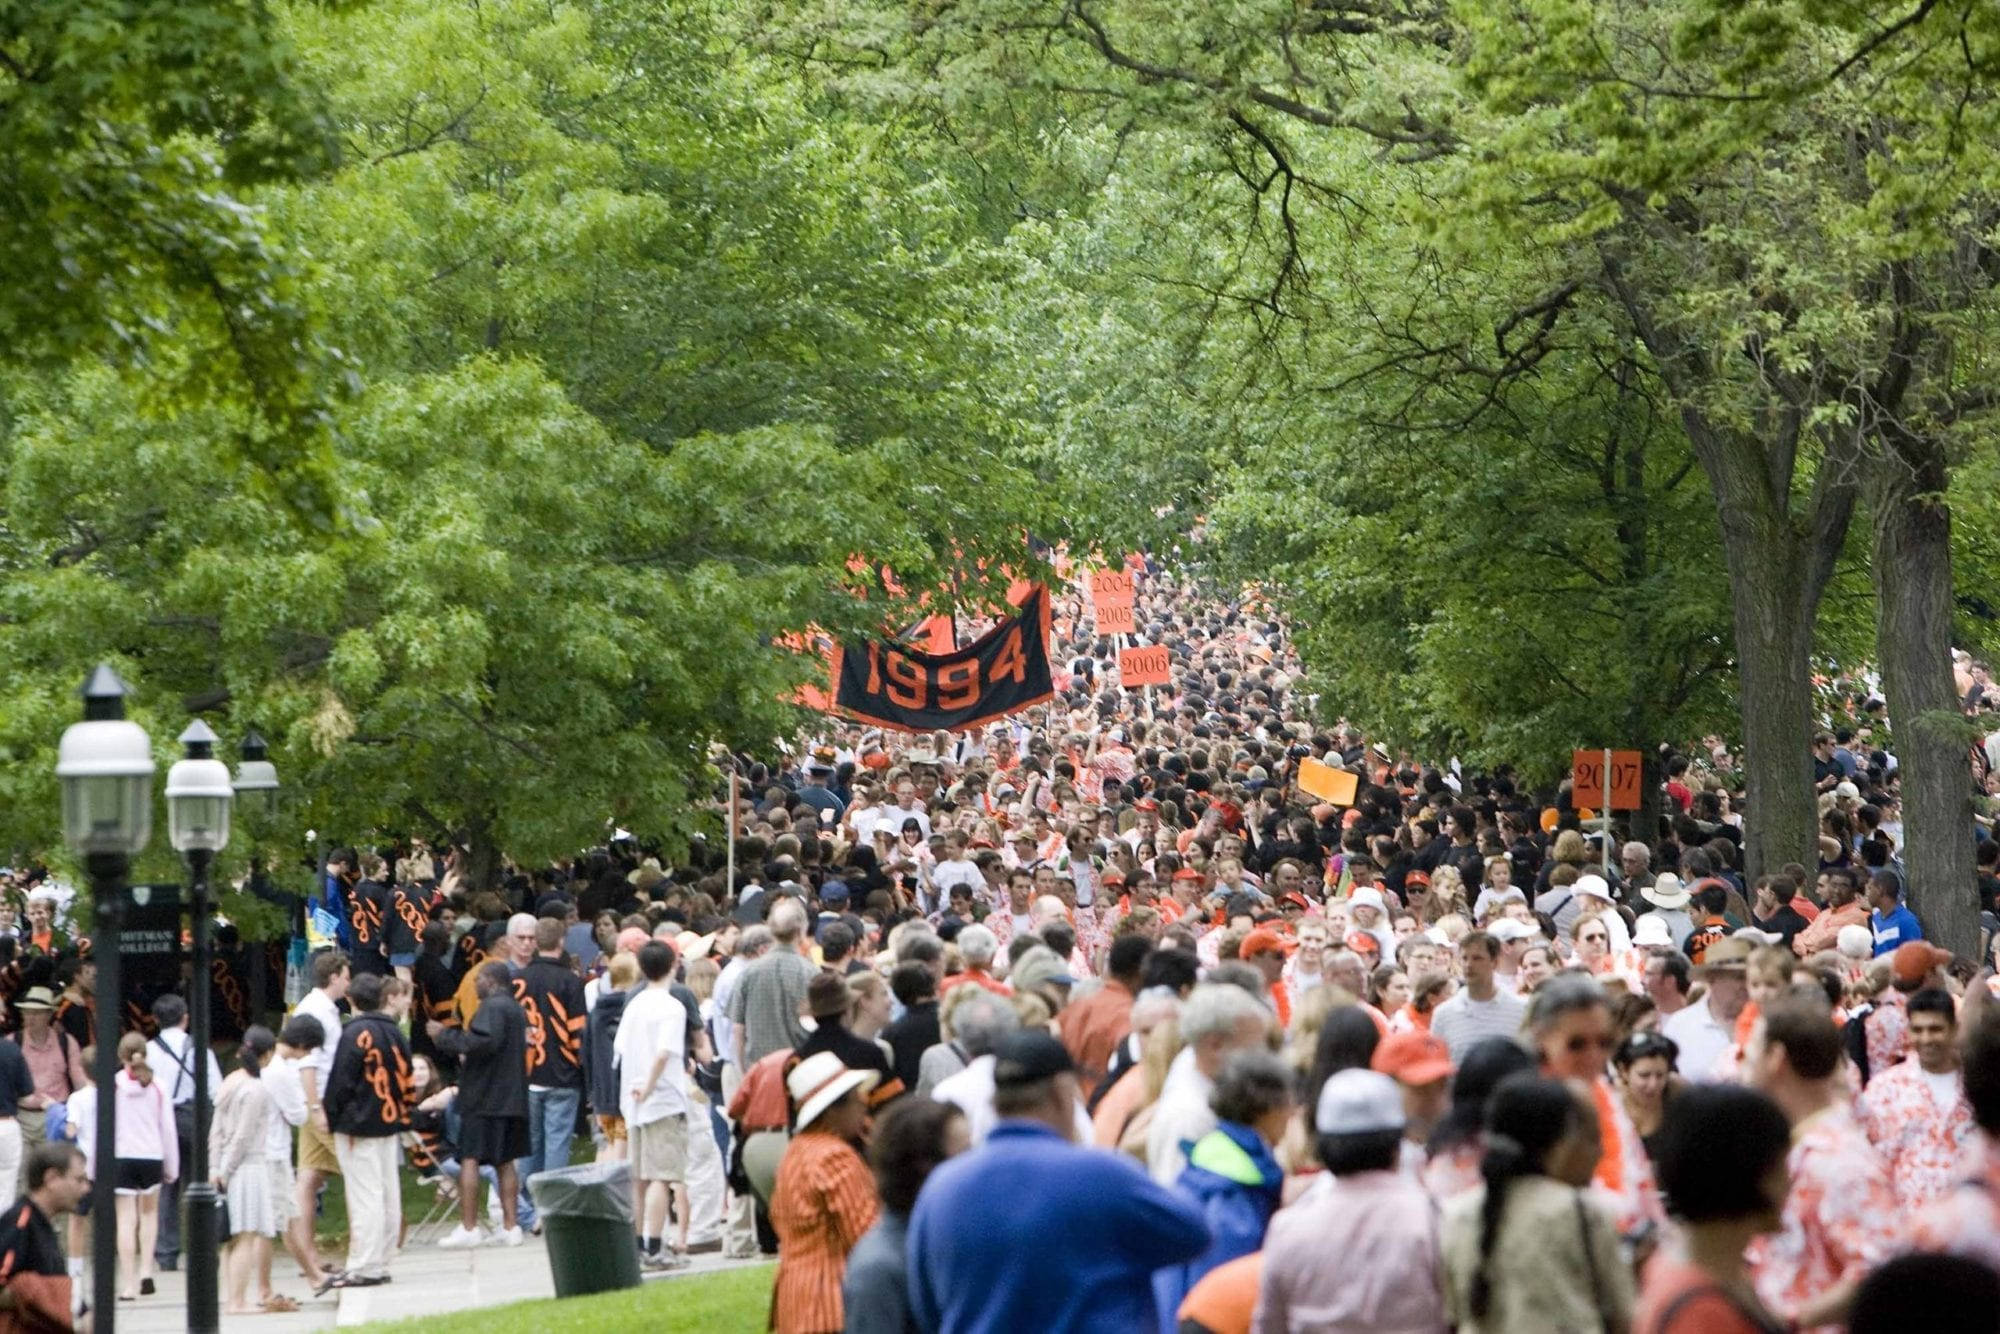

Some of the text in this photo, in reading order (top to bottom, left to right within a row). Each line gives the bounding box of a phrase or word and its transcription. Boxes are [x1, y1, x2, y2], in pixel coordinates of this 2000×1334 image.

[1094, 575, 1133, 593] 2004
[1097, 606, 1131, 624] 2005
[867, 624, 1026, 711] 1994
[1122, 654, 1166, 676] 2006
[1577, 762, 1637, 790] 2007
[119, 942, 170, 953] OLLEGE
